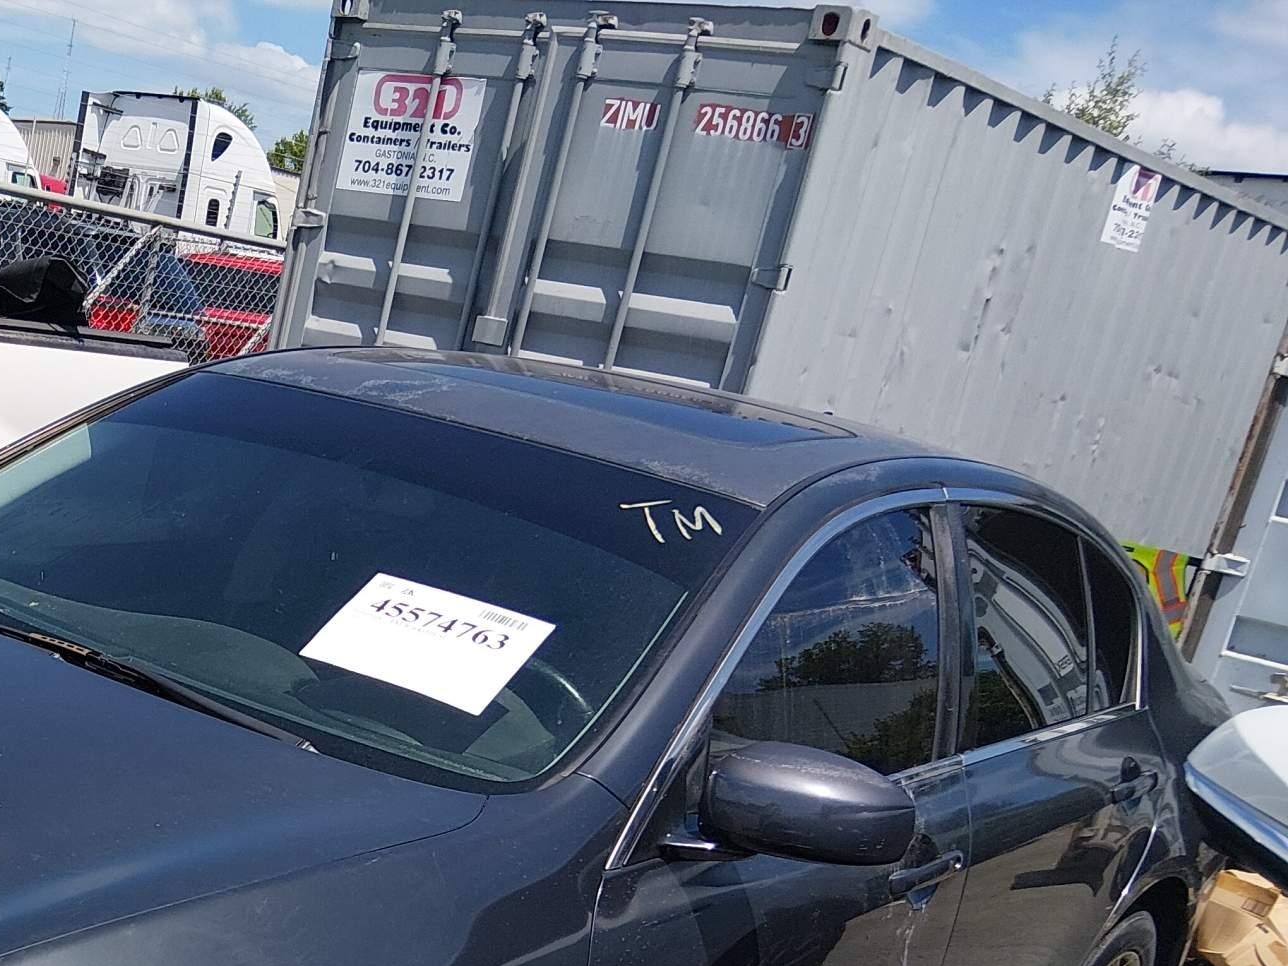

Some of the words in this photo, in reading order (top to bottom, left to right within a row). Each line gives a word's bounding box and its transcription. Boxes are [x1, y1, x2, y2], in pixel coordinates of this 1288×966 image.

[440, 122, 462, 136] Co.
[599, 98, 662, 131] ZIMU
[695, 106, 783, 143] 256866
[789, 114, 811, 148] 3
[348, 132, 412, 148] Containers
[425, 138, 472, 153] railers
[353, 159, 455, 182] 704-8672317
[350, 177, 451, 196] www.321equipent.com
[619, 499, 724, 545] TM
[370, 599, 510, 651] 45574763
